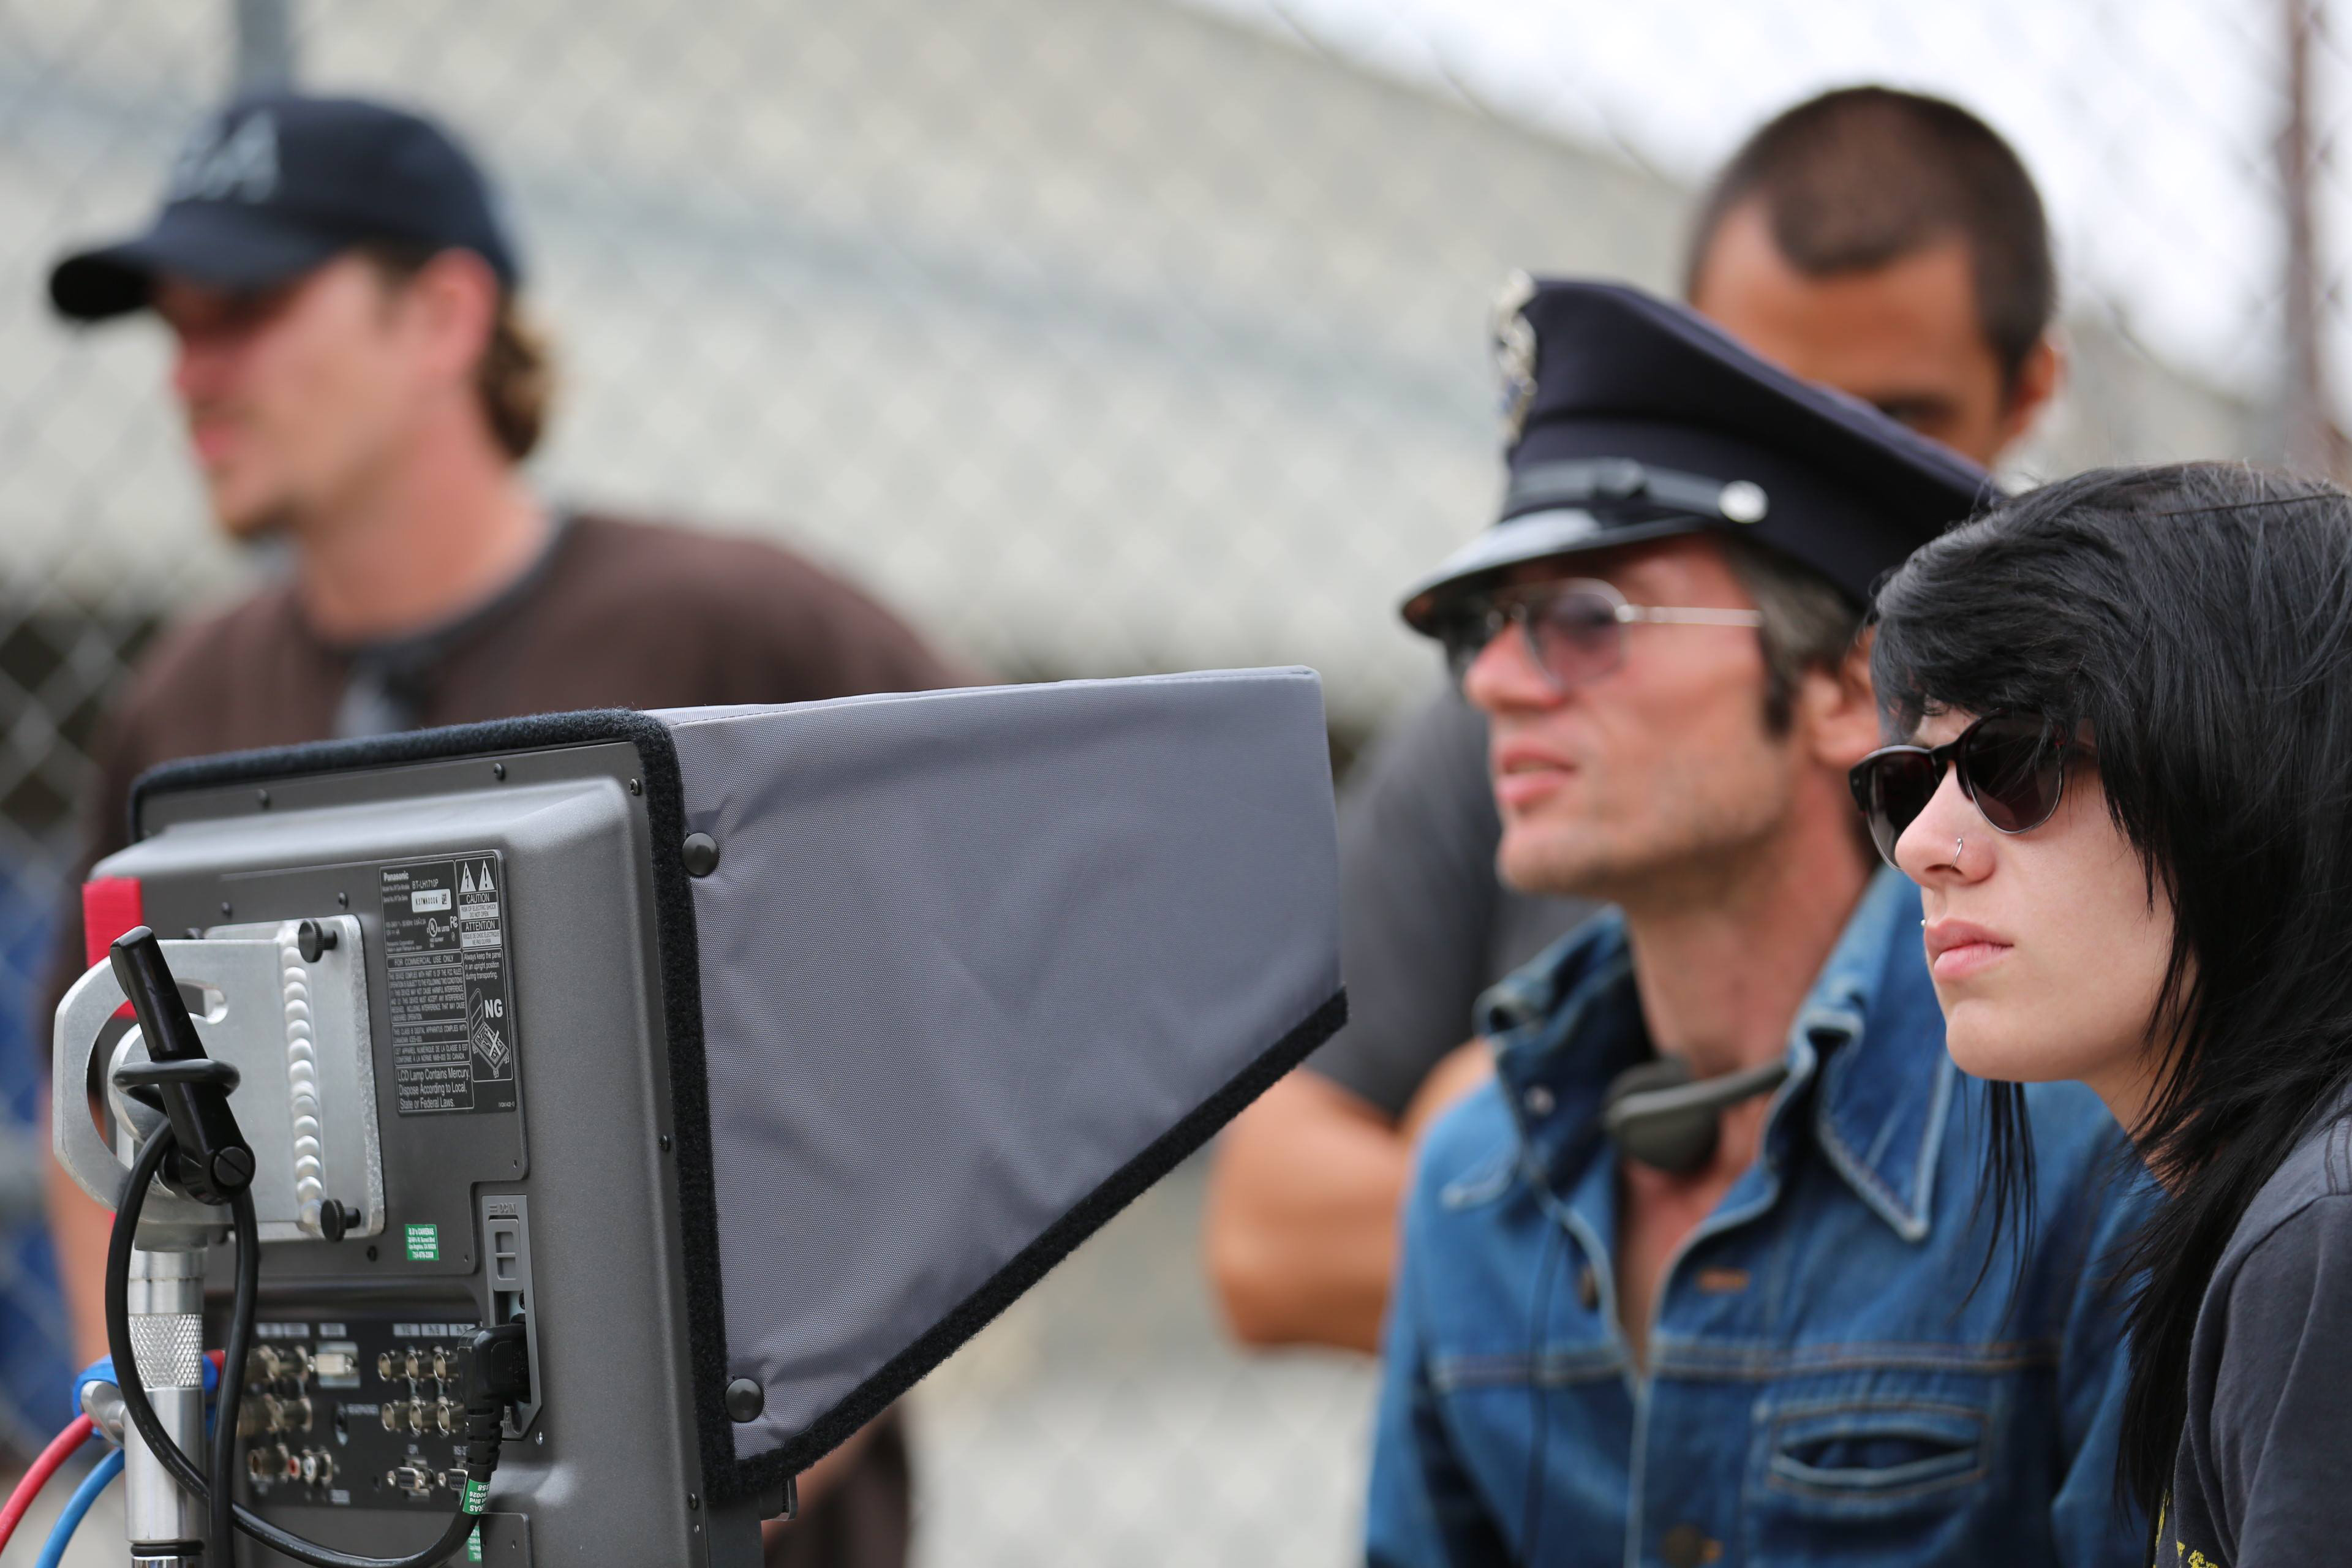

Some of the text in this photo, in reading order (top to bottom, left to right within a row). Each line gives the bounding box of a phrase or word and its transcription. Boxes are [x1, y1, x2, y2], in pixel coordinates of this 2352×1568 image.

[383, 870, 409, 881] Panasonic
[412, 878, 439, 889] BT-LH1710P
[466, 893, 490, 904] CAUTION
[466, 920, 496, 932] ATTENTION
[404, 956, 432, 966] COMMERCIAL
[464, 953, 476, 962] Always
[492, 950, 502, 960] panel
[473, 962, 486, 971] upright
[486, 961, 500, 970] position
[466, 971, 498, 981] during transporting.
[484, 998, 503, 1018] NG
[398, 1067, 470, 1082] LCD Lamp Contains Mercury.
[399, 1082, 467, 1096] Dispose According to Local,
[399, 1096, 455, 1110] State or Federal Laws.
